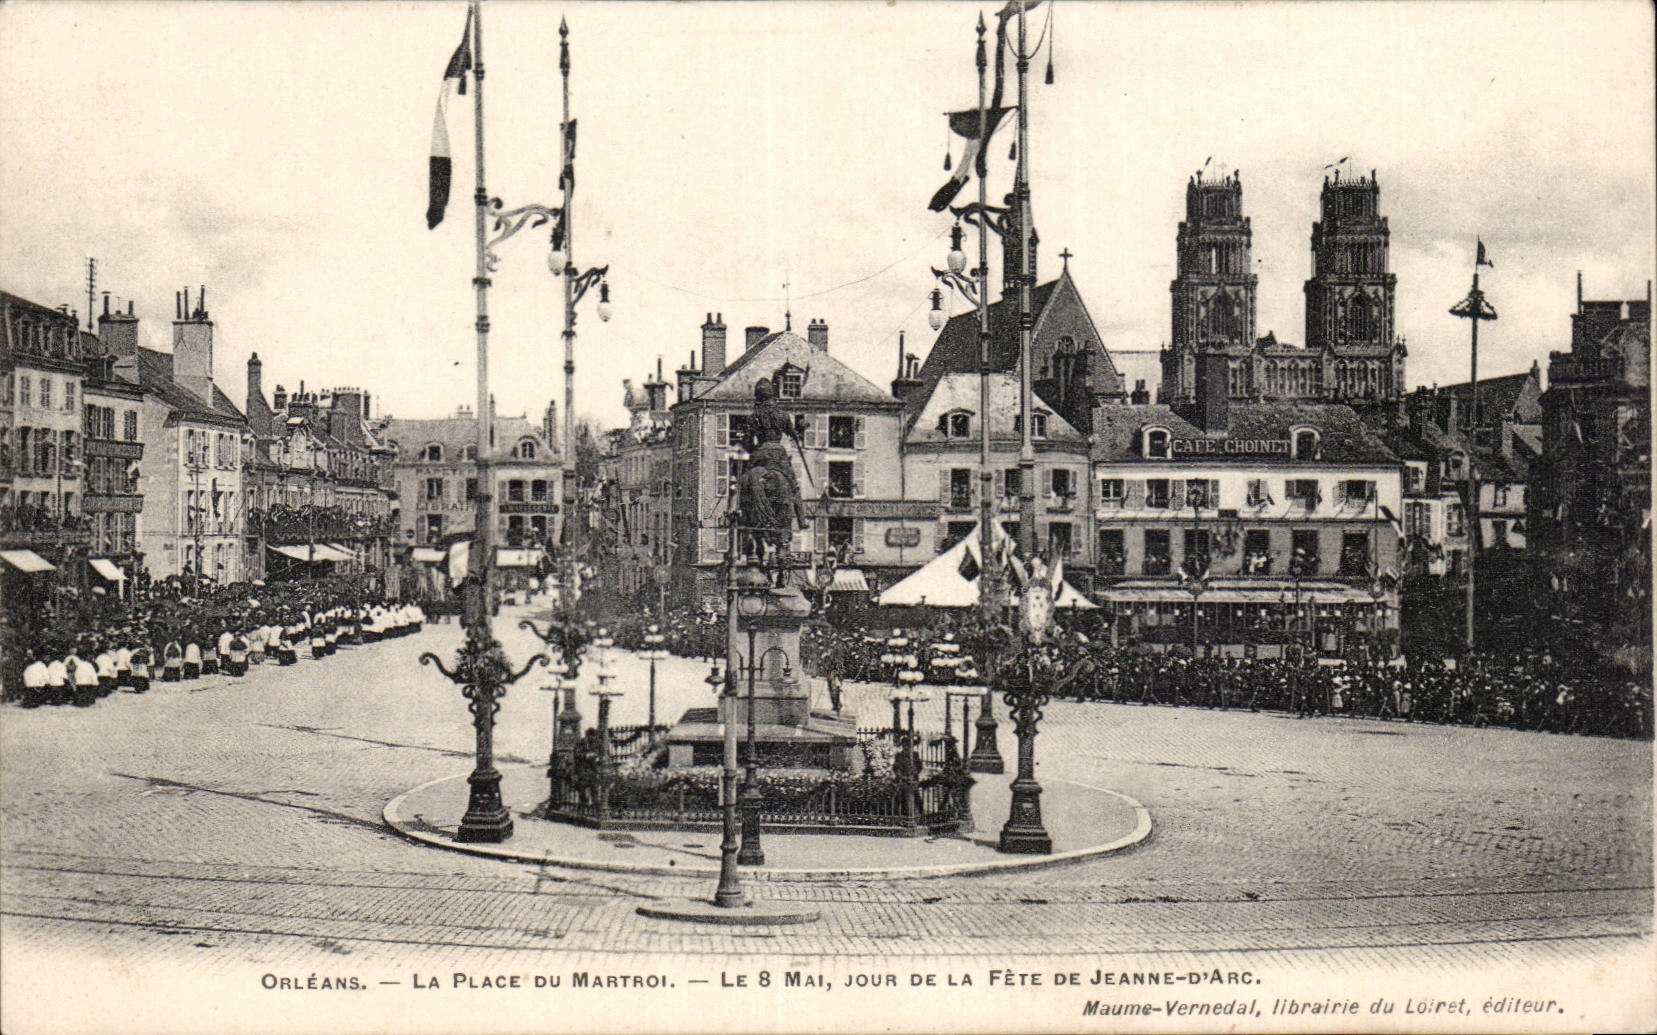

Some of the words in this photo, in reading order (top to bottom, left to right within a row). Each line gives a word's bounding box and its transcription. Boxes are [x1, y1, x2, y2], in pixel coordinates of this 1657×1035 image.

[1224, 439, 1291, 453] CHOINET
[416, 468, 477, 476] PAPETER
[416, 502, 477, 511] LIBRAIR
